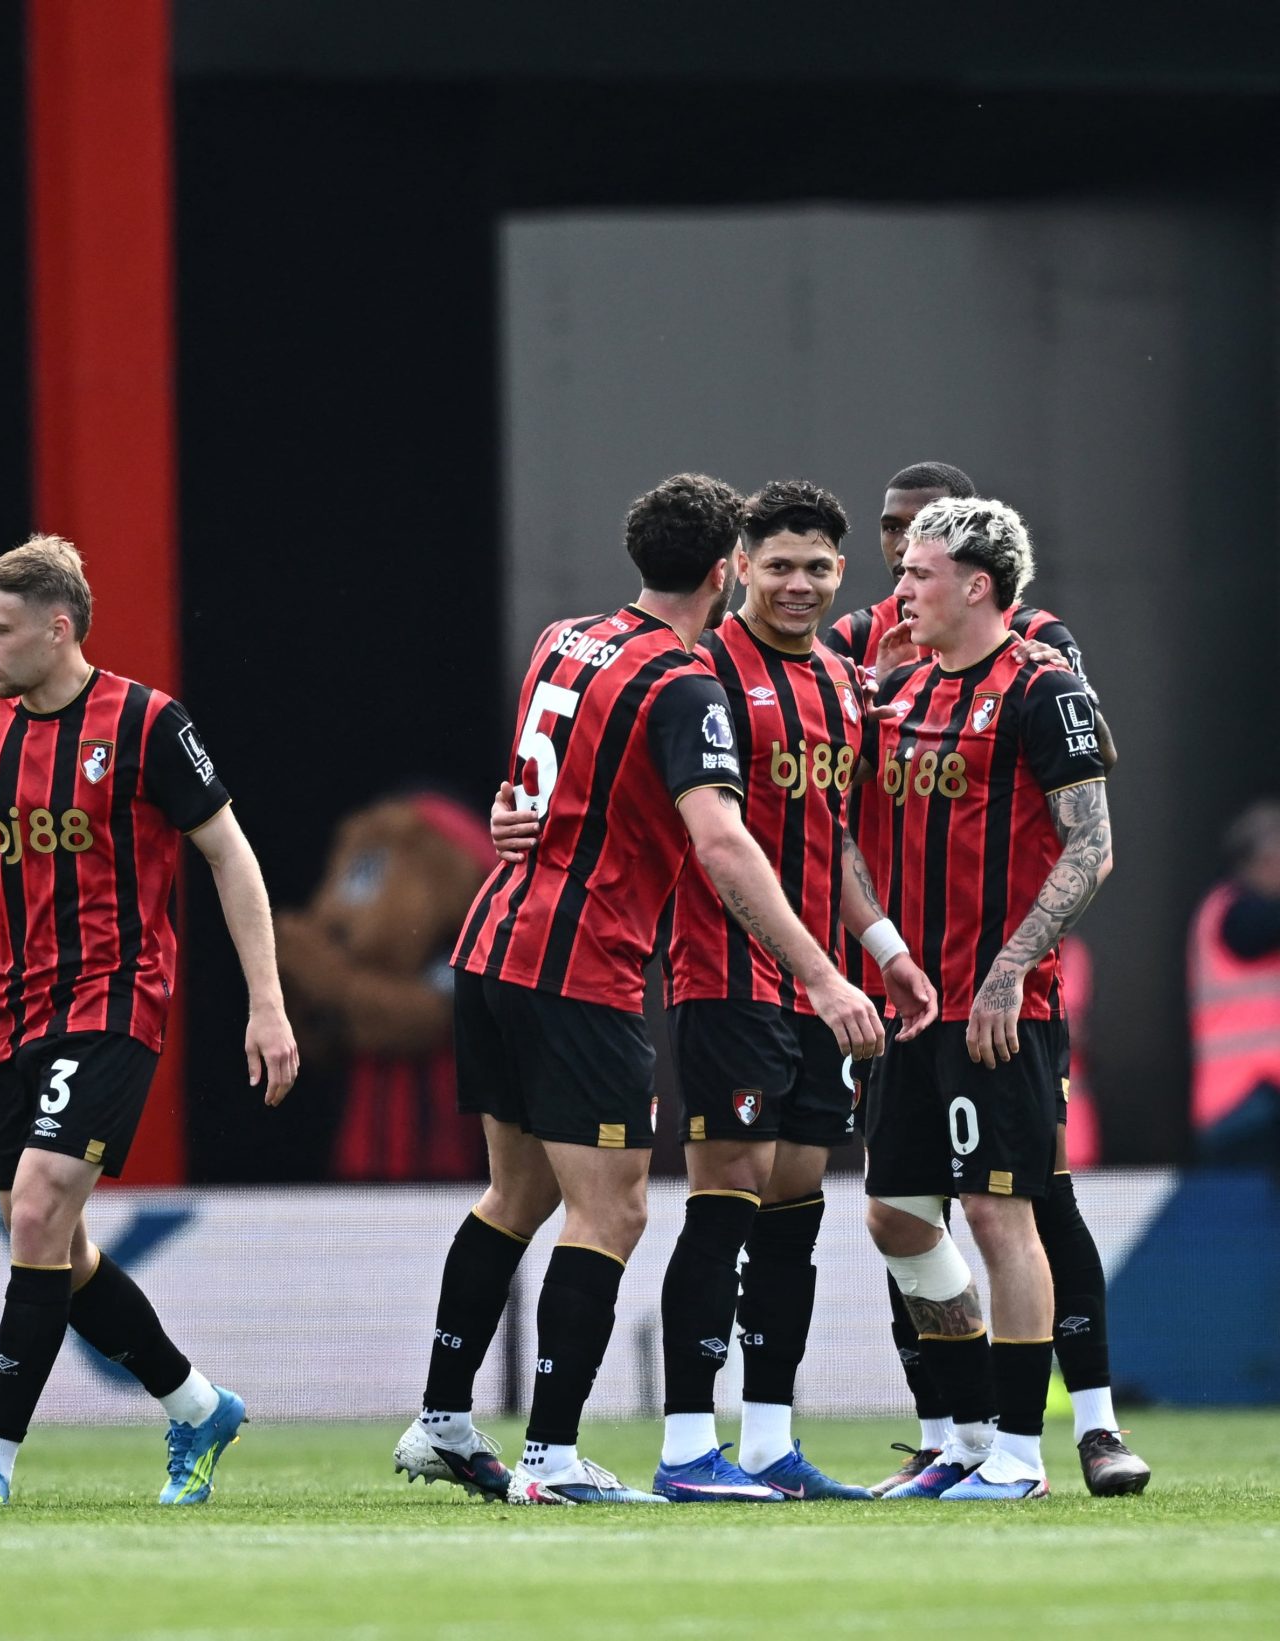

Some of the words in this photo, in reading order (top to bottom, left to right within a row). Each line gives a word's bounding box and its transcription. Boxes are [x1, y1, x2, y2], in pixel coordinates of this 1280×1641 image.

[551, 627, 624, 670] SENESI
[752, 699, 775, 707] umbro
[514, 680, 580, 820] 5
[702, 752, 717, 763] No
[703, 760, 718, 770] for
[771, 740, 854, 799] bj88
[884, 746, 968, 807] bj88
[40, 1058, 80, 1114] 3
[34, 1129, 57, 1138] umbro
[949, 1096, 980, 1156] 0
[434, 1328, 462, 1349] FCB
[744, 1333, 764, 1345] CB
[537, 1358, 553, 1374] CB
